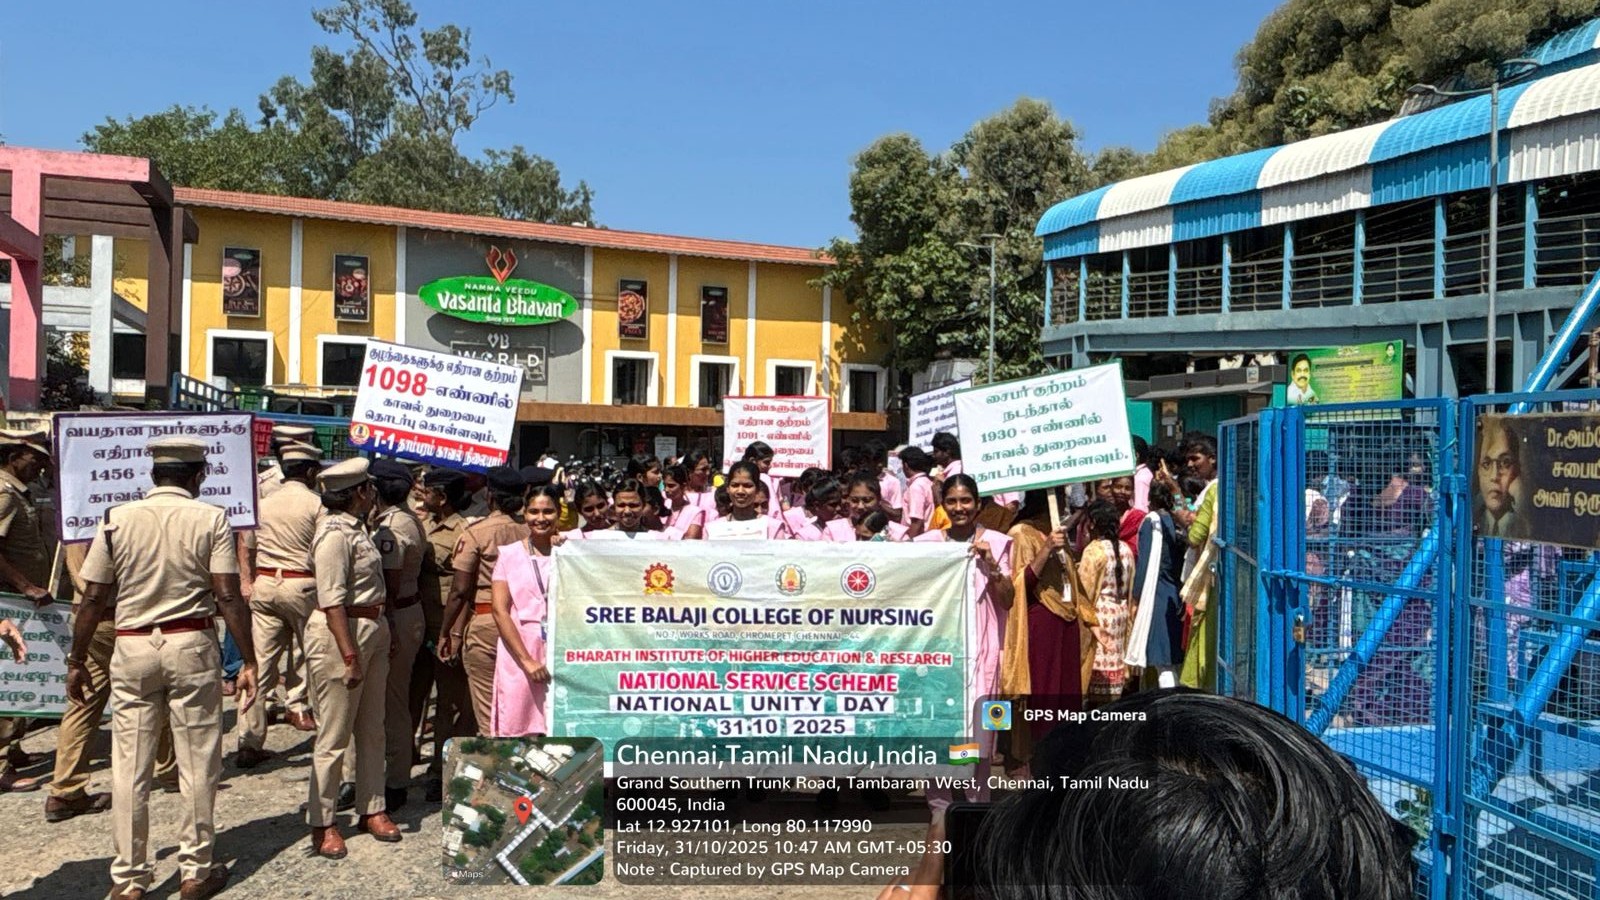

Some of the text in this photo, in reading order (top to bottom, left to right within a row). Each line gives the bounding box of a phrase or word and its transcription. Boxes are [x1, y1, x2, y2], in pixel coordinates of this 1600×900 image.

[464, 283, 538, 296] NAMMA VEEDU
[437, 290, 501, 314] Vasanta
[369, 346, 518, 384] குழந்தைகளுக்கு எதிரான குற்றம்
[986, 375, 1087, 405] சைபர் குற்றம்
[365, 409, 416, 430] தொடர்பு
[383, 397, 486, 425] காவல் துறையை
[1002, 397, 1073, 423] நடந்தால்
[65, 420, 247, 439] வயதான நபர்களுக்கு
[736, 431, 758, 440] 1091
[981, 427, 1017, 444] 1930
[1030, 412, 1102, 435] எண்ணில்
[373, 430, 397, 450] T-1
[981, 434, 1107, 462] காவல் துறையை
[91, 468, 135, 481] 1456
[1533, 486, 1571, 508] அவர்
[585, 606, 934, 627] SREE BALAJI COLLEGE OF NURSING
[679, 630, 710, 639] WORKS
[566, 650, 952, 666] BHARATH INSTITUTE OF HIGHER EDUCATION & RESEARCH
[619, 672, 899, 692] NATIONAL SERVICE SCHEME
[616, 696, 890, 712] NATIONAL UNITY DAY
[792, 719, 846, 735] 2025
